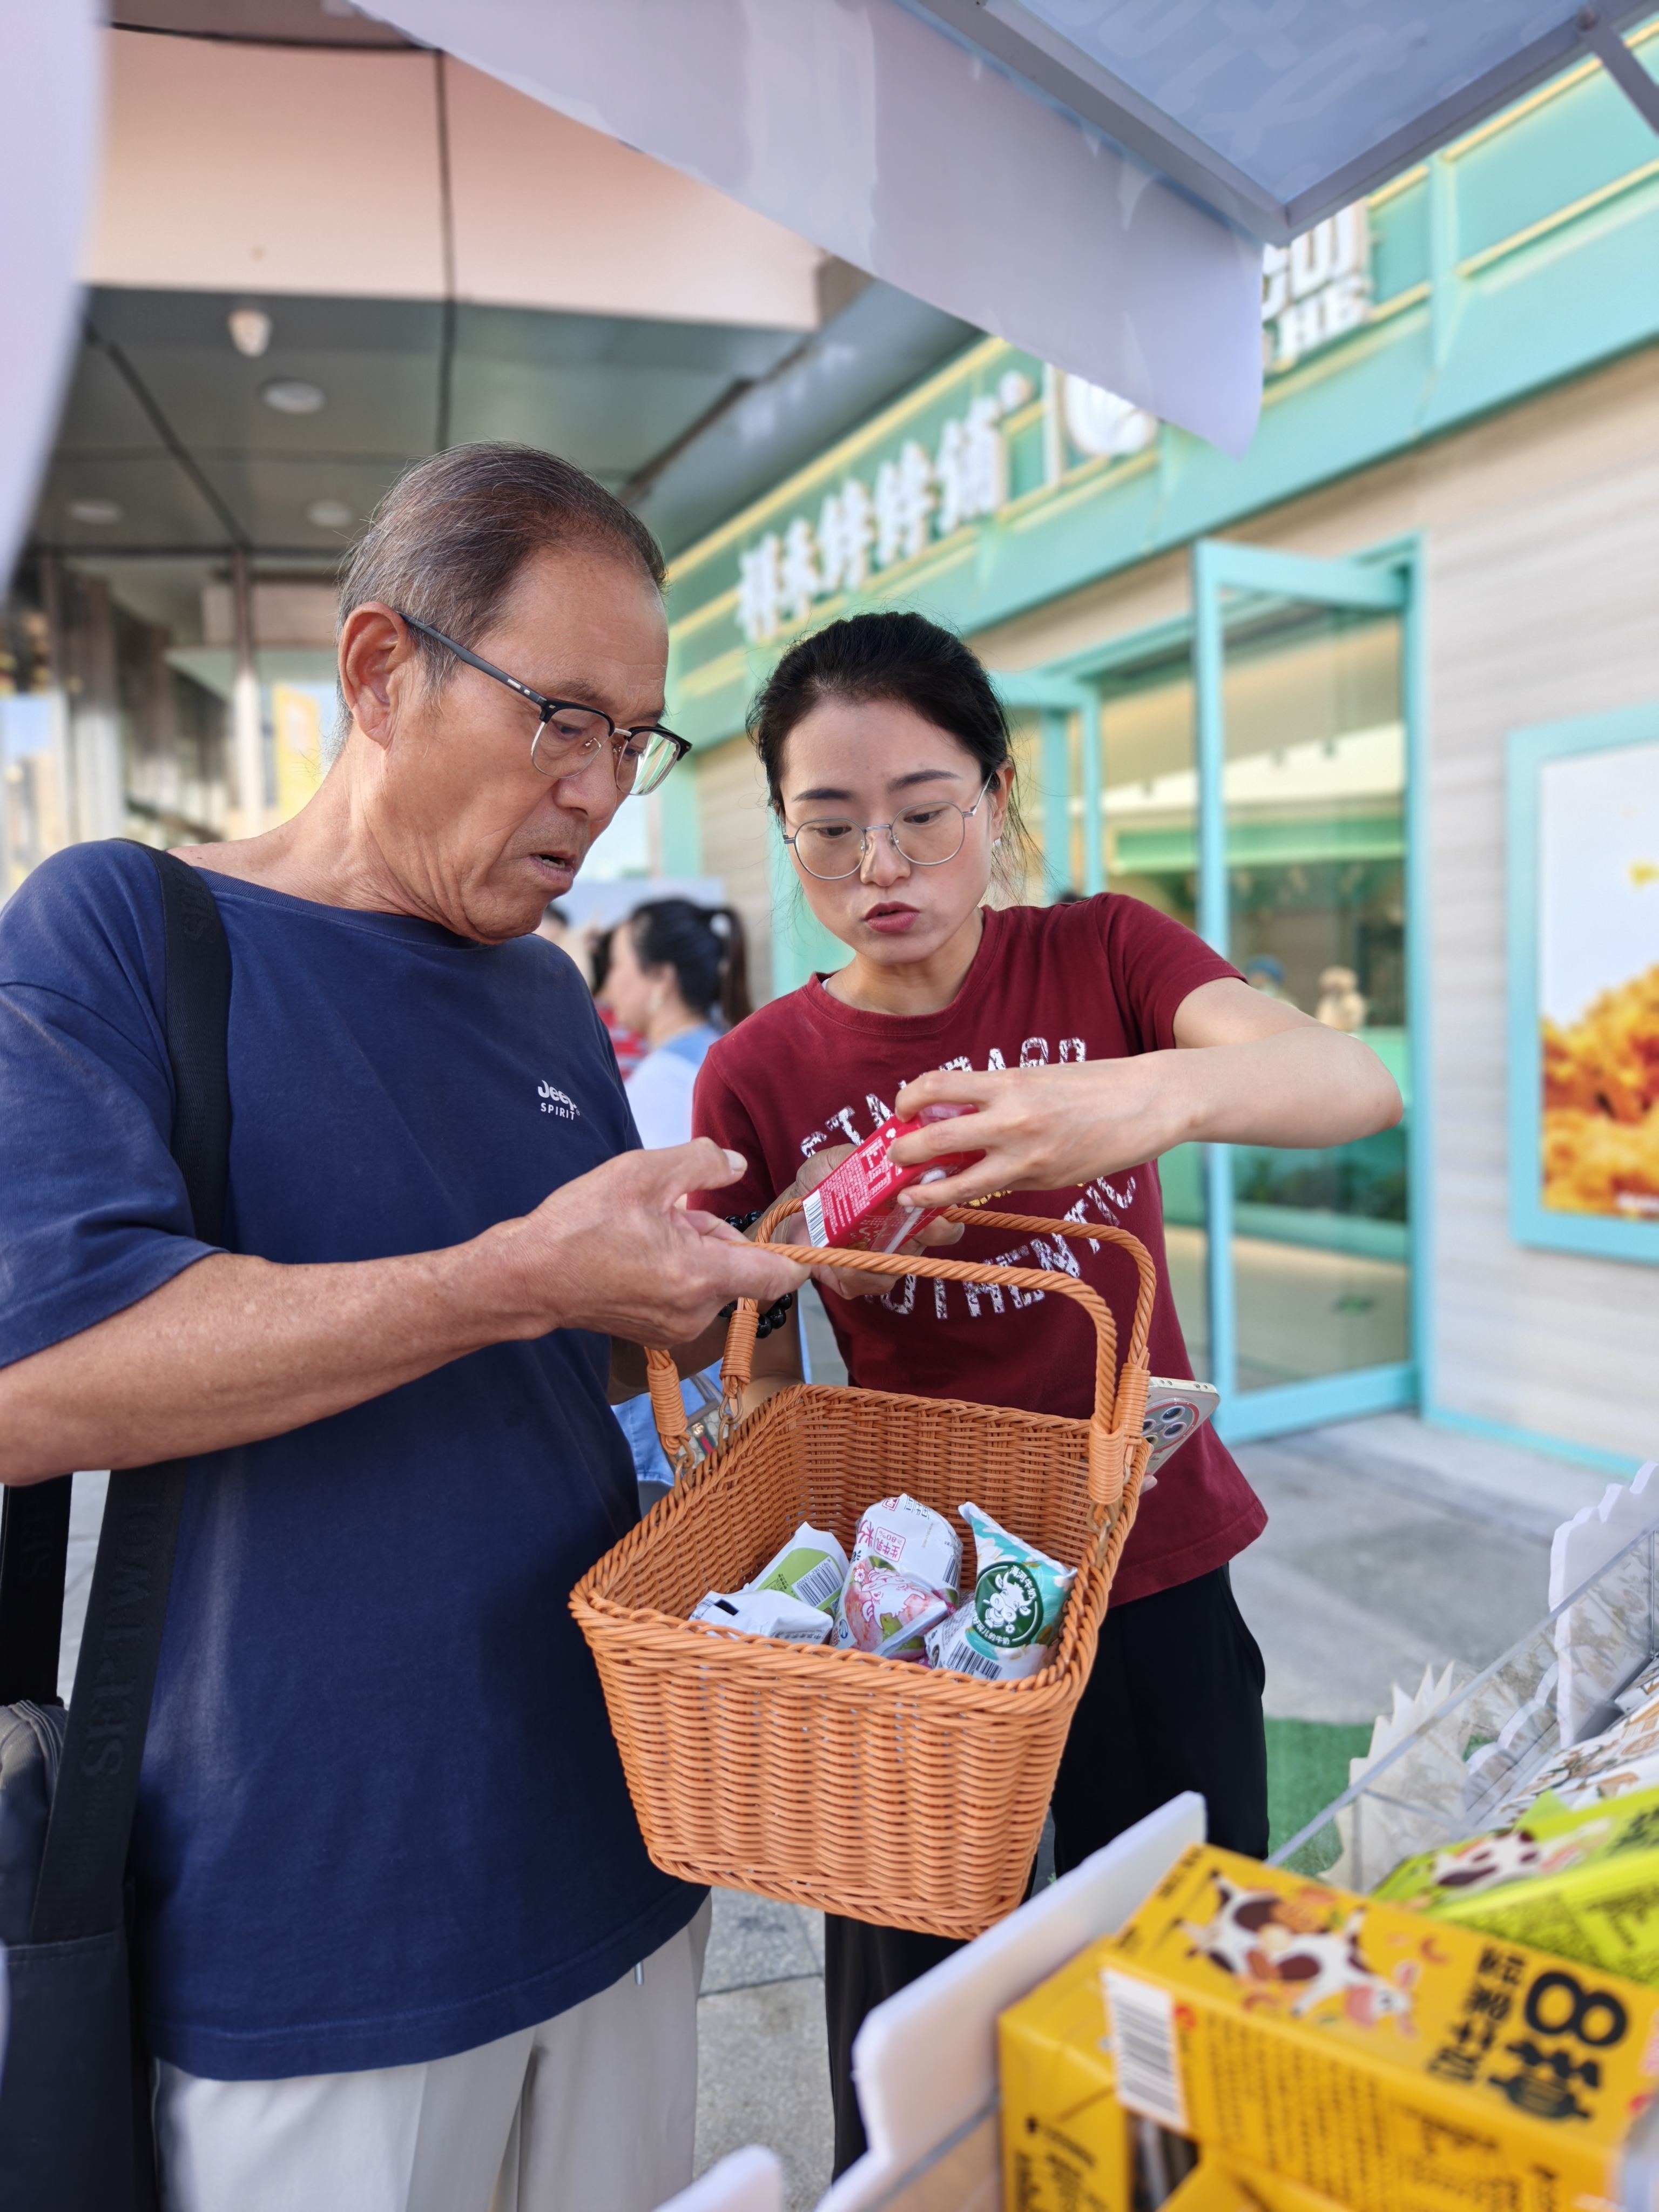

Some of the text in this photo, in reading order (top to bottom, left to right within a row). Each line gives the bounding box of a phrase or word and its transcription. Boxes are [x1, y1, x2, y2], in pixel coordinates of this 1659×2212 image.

[537, 1080, 577, 1111] Jeep
[541, 1102, 575, 1120] SPIRIT
[876, 1537, 900, 1558] 生牛乳
[1009, 1565, 1037, 1600] 海河牛奶
[973, 1616, 1010, 1645] 好玩儿的牛奶
